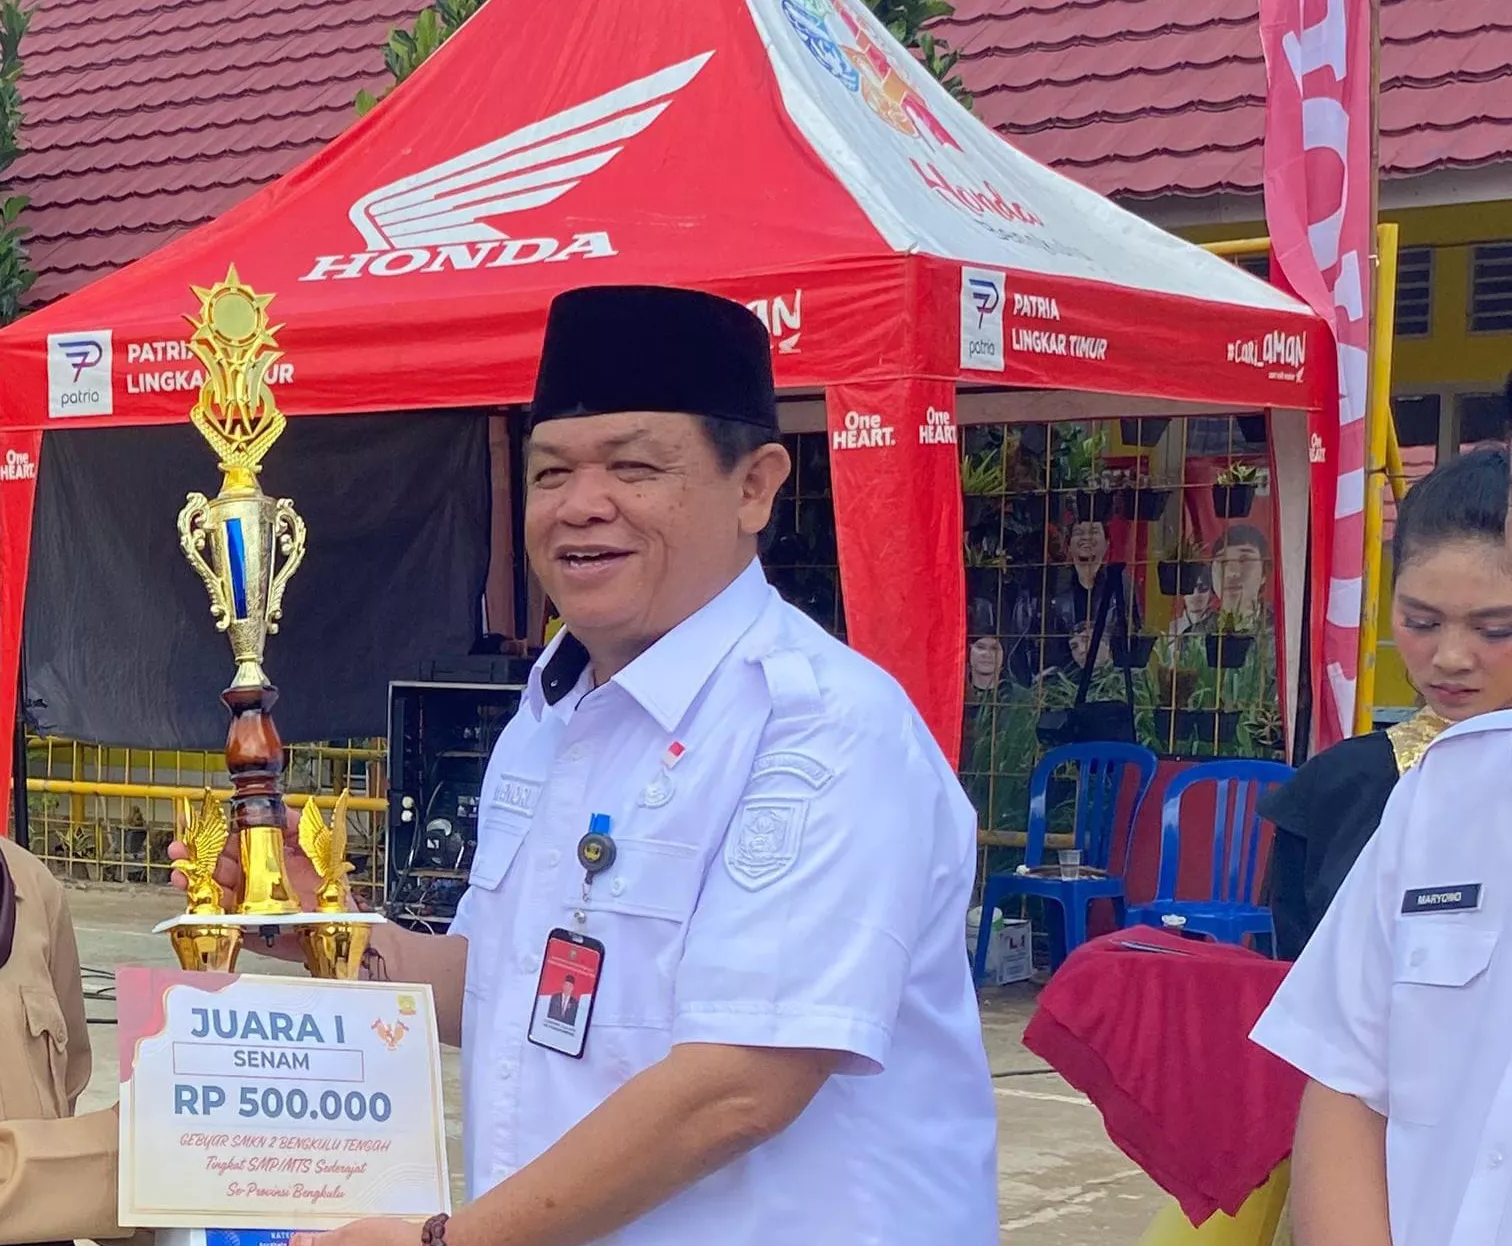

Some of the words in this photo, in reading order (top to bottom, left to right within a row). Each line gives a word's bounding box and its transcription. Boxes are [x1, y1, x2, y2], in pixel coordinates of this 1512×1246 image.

[297, 231, 620, 281] HONDA
[1013, 293, 1060, 321] PATRIA
[128, 340, 194, 363] PATRI
[1011, 327, 1067, 356] LINGKAR
[1068, 335, 1108, 360] TIMUR
[127, 370, 204, 394] LINGKA
[61, 388, 99, 408] patria
[845, 411, 881, 430] One
[926, 406, 950, 425] One
[832, 427, 896, 450] HEART.
[6, 449, 29, 464] One
[191, 1008, 324, 1044] JUARA
[334, 1014, 345, 1044] I
[233, 1050, 309, 1071] SENAM
[174, 1084, 226, 1116] RP
[238, 1086, 392, 1122] 500.000
[180, 1133, 230, 1150] GEBYAR
[230, 1135, 267, 1149] SMKN
[268, 1135, 278, 1149] 2
[279, 1136, 341, 1151] BENGKULU
[342, 1138, 391, 1152] TENGAH
[205, 1155, 247, 1176] Tingkat
[247, 1157, 313, 1173] SMP/MTS
[315, 1159, 368, 1179] Sederajat
[292, 1183, 345, 1204] Bengkulu
